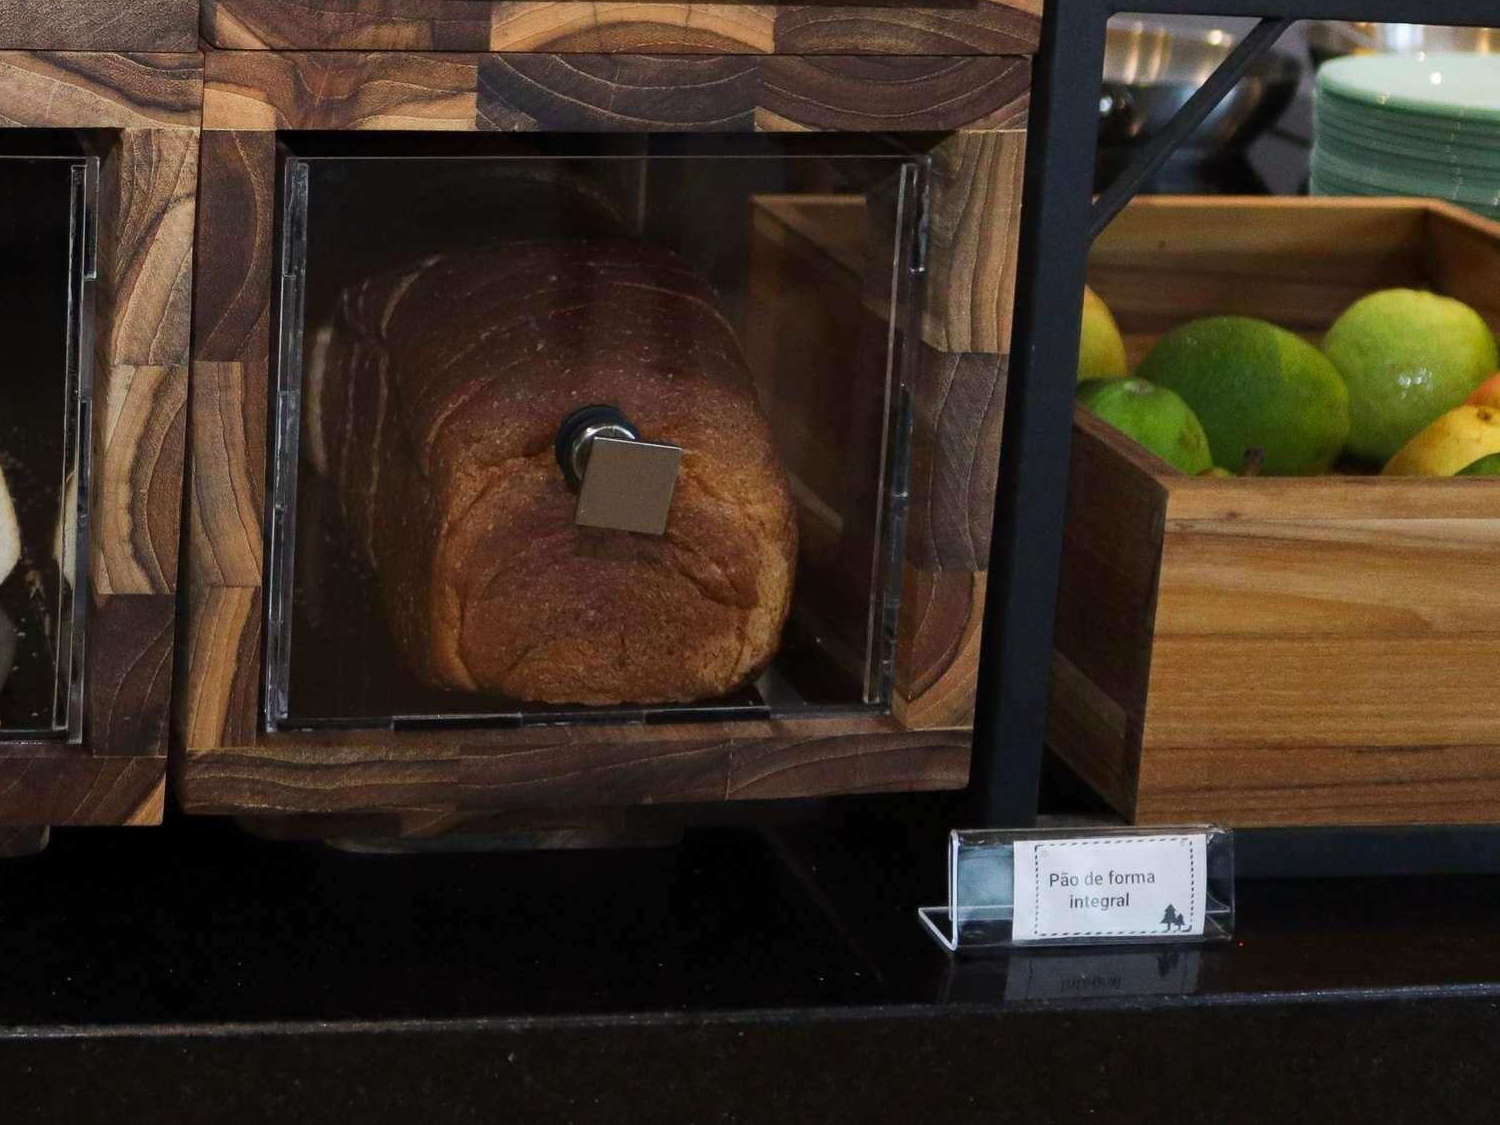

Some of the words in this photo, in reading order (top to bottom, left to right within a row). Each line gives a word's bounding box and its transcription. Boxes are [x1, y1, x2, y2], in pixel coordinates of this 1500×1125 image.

[1049, 872, 1080, 887] Pão
[1084, 871, 1104, 886] de
[1108, 869, 1156, 885] forma
[1069, 891, 1130, 911] integral
